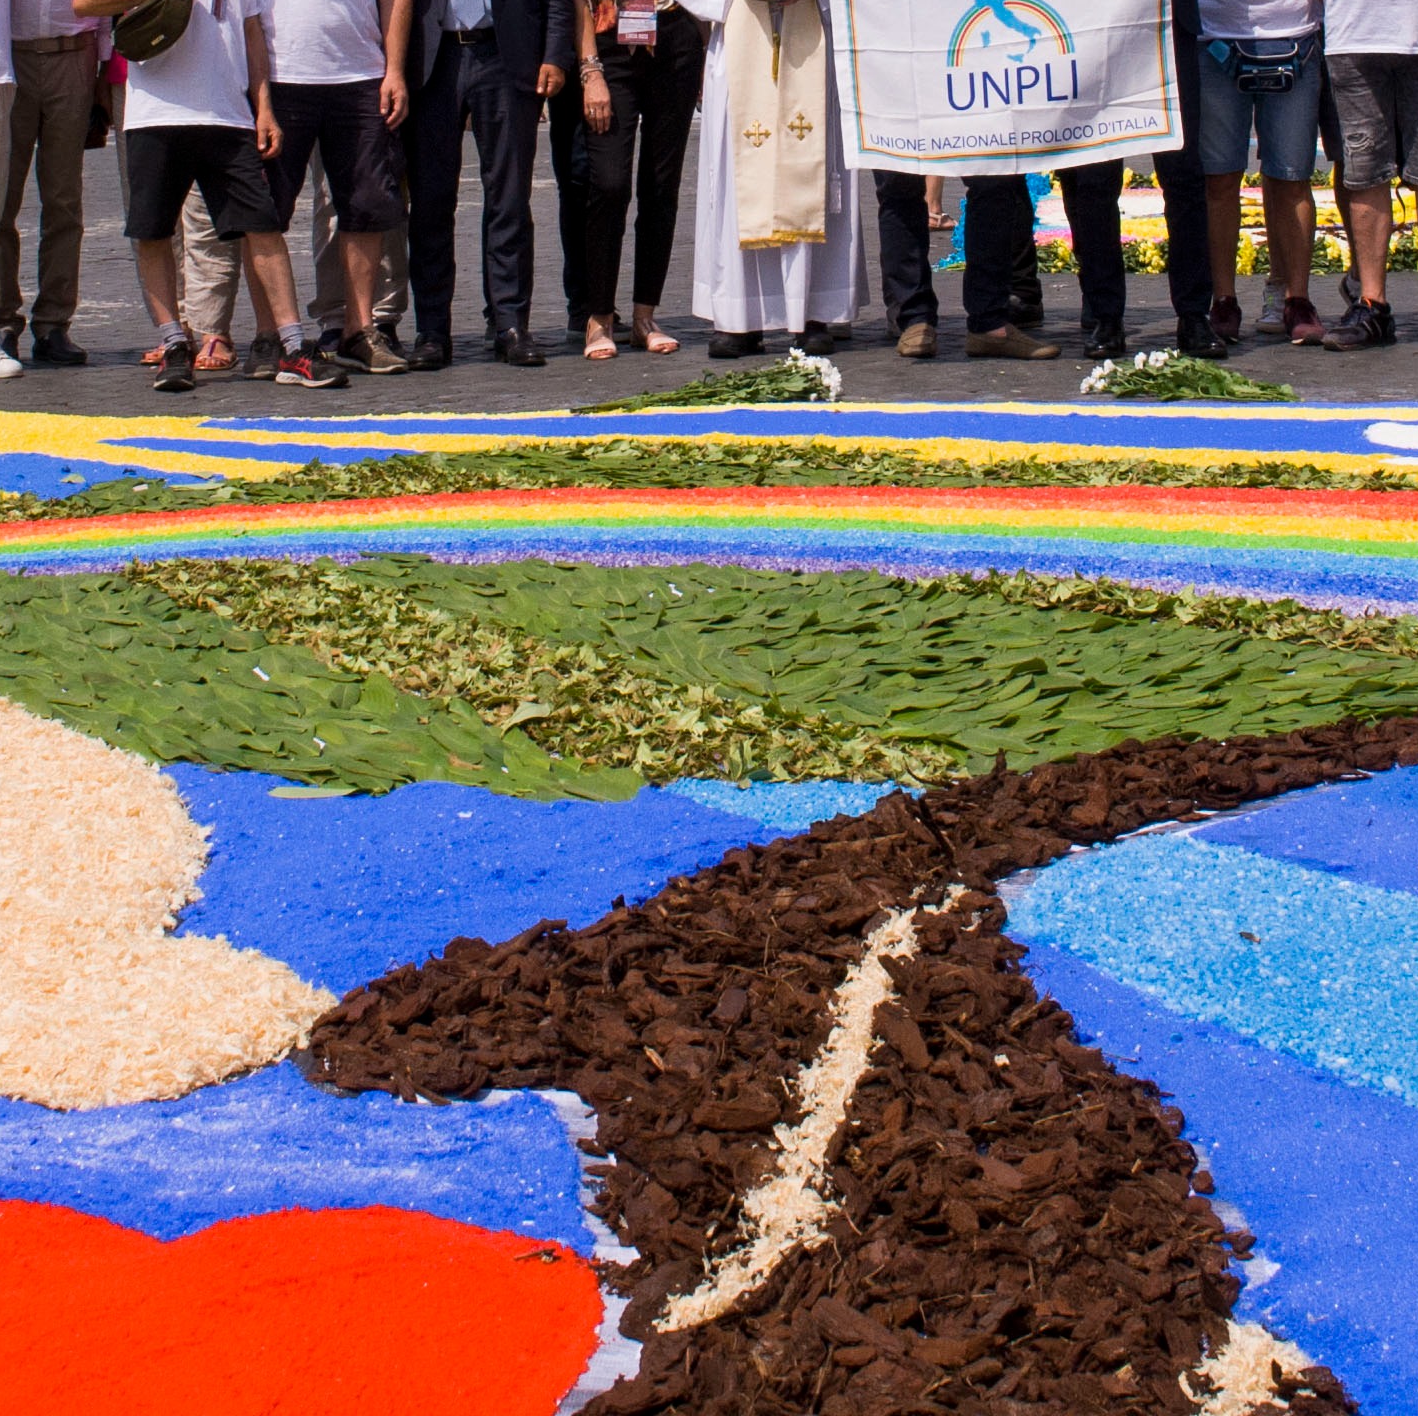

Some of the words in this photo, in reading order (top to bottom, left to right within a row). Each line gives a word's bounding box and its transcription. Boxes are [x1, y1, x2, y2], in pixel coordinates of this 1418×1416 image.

[946, 59, 1080, 112] UNPLI
[870, 131, 928, 153] UNIONE
[930, 131, 1018, 152] NAZIONALE
[1020, 123, 1095, 147] PROLOCO
[1097, 114, 1159, 138] D'ITALIA
